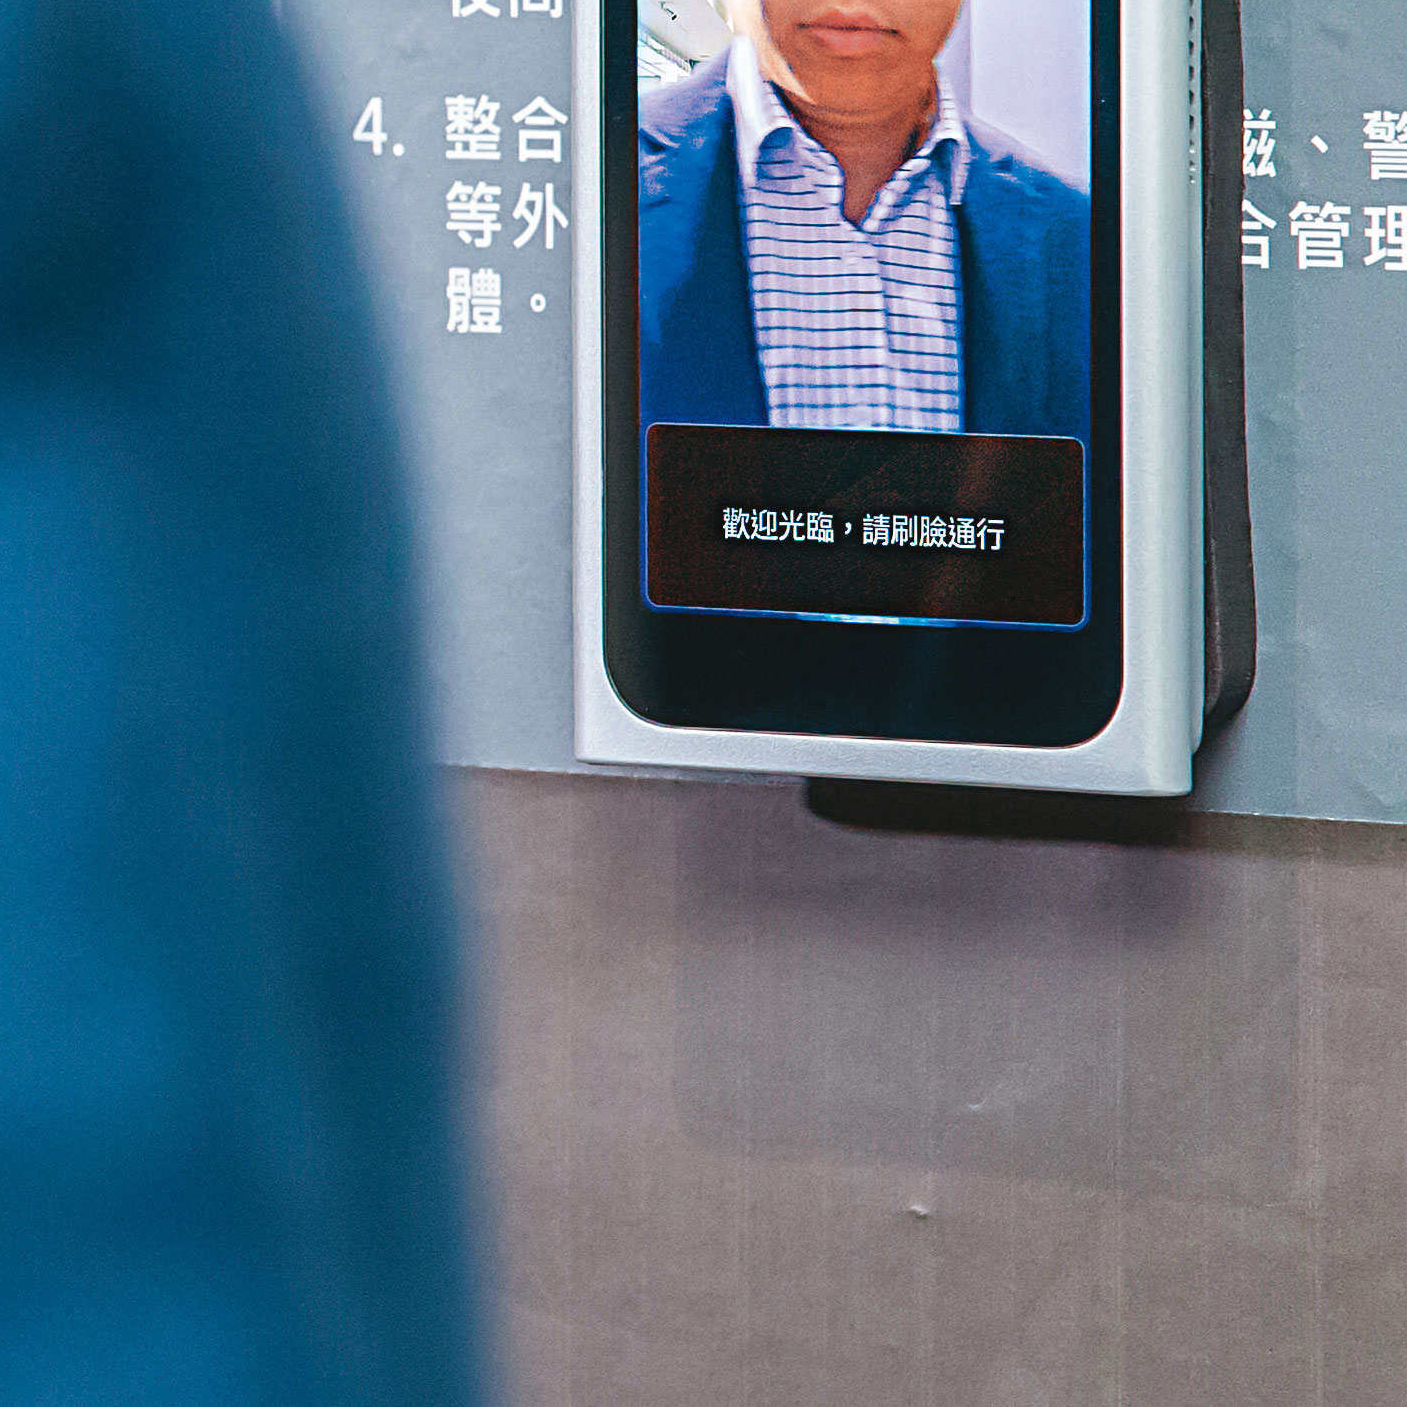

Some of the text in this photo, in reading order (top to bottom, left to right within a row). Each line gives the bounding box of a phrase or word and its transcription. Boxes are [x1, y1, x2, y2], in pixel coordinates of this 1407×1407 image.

[352, 97, 405, 156] 4.
[444, 94, 568, 162] 整合
[445, 180, 569, 250] 等外
[446, 266, 547, 333] 體。
[723, 507, 1004, 551] 歡迎光臨，請刷臉通行
